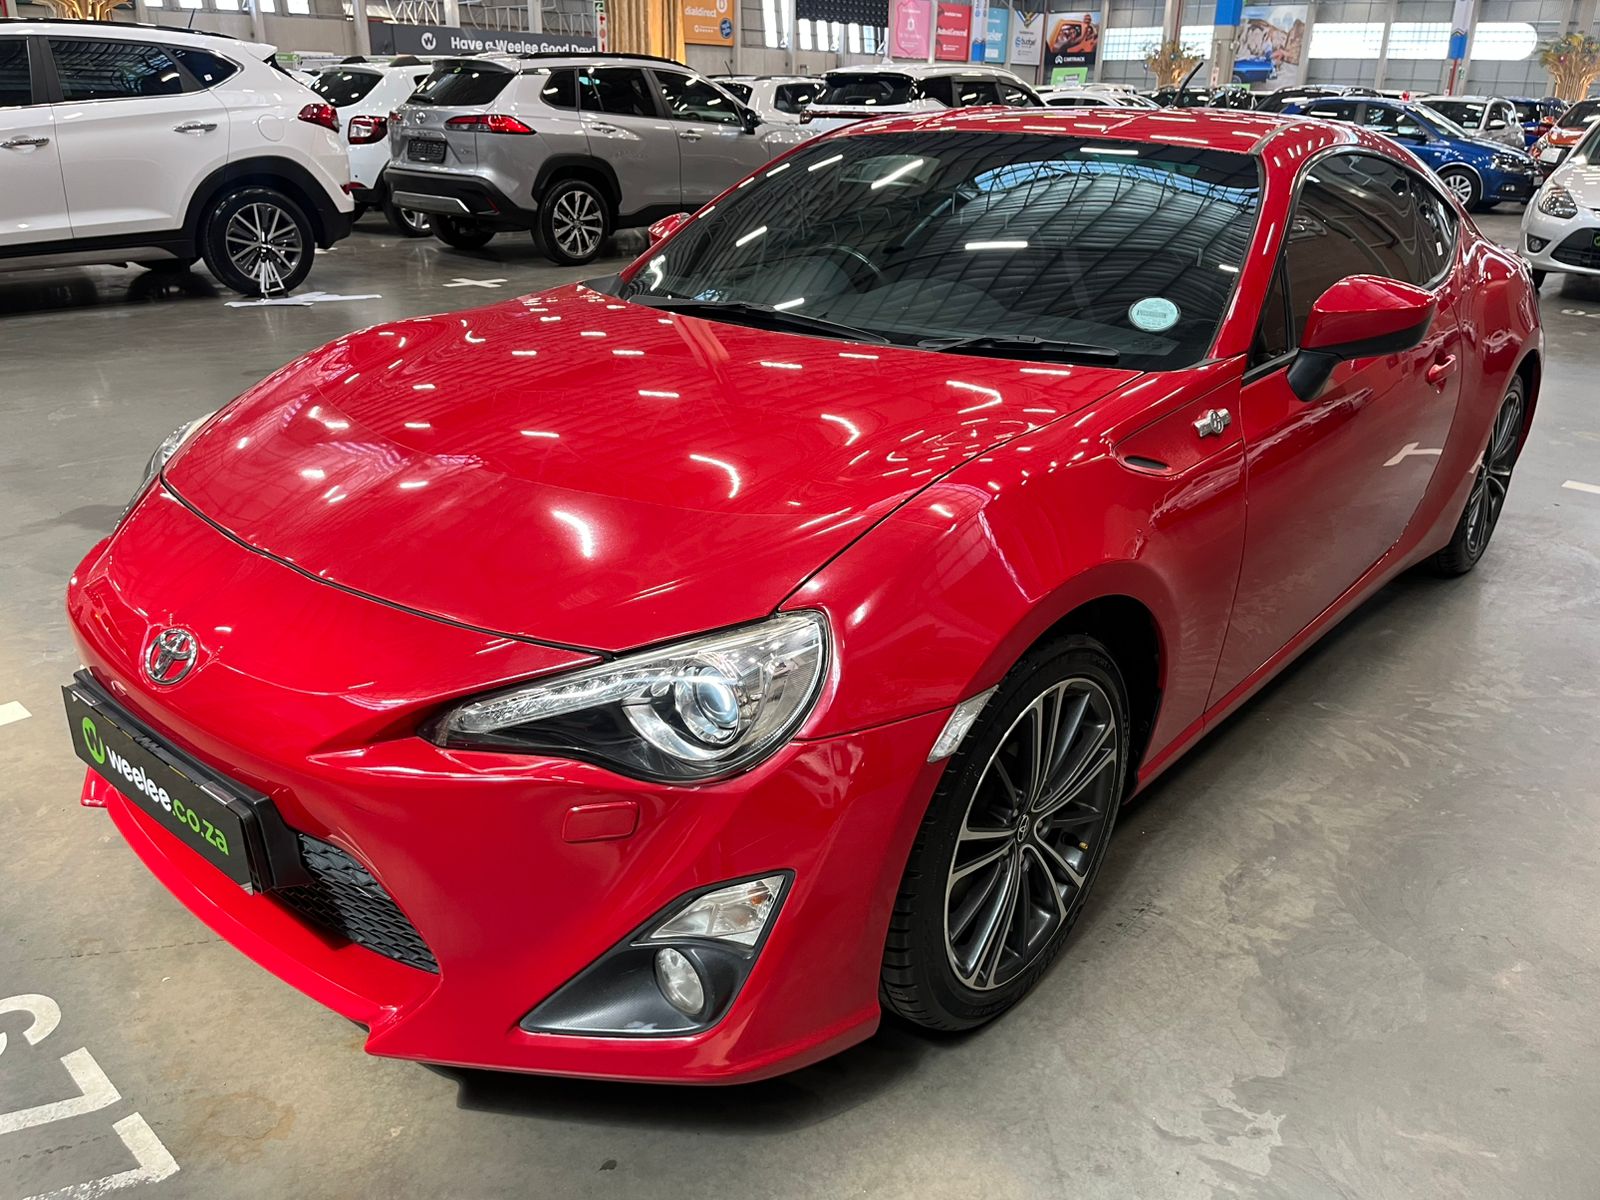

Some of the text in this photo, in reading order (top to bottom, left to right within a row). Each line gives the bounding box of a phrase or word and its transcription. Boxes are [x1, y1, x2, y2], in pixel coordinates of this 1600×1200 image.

[450, 36, 484, 51] Have
[496, 39, 538, 53] Weelee
[540, 42, 569, 53] Good
[106, 745, 229, 856] weelee.co.za
